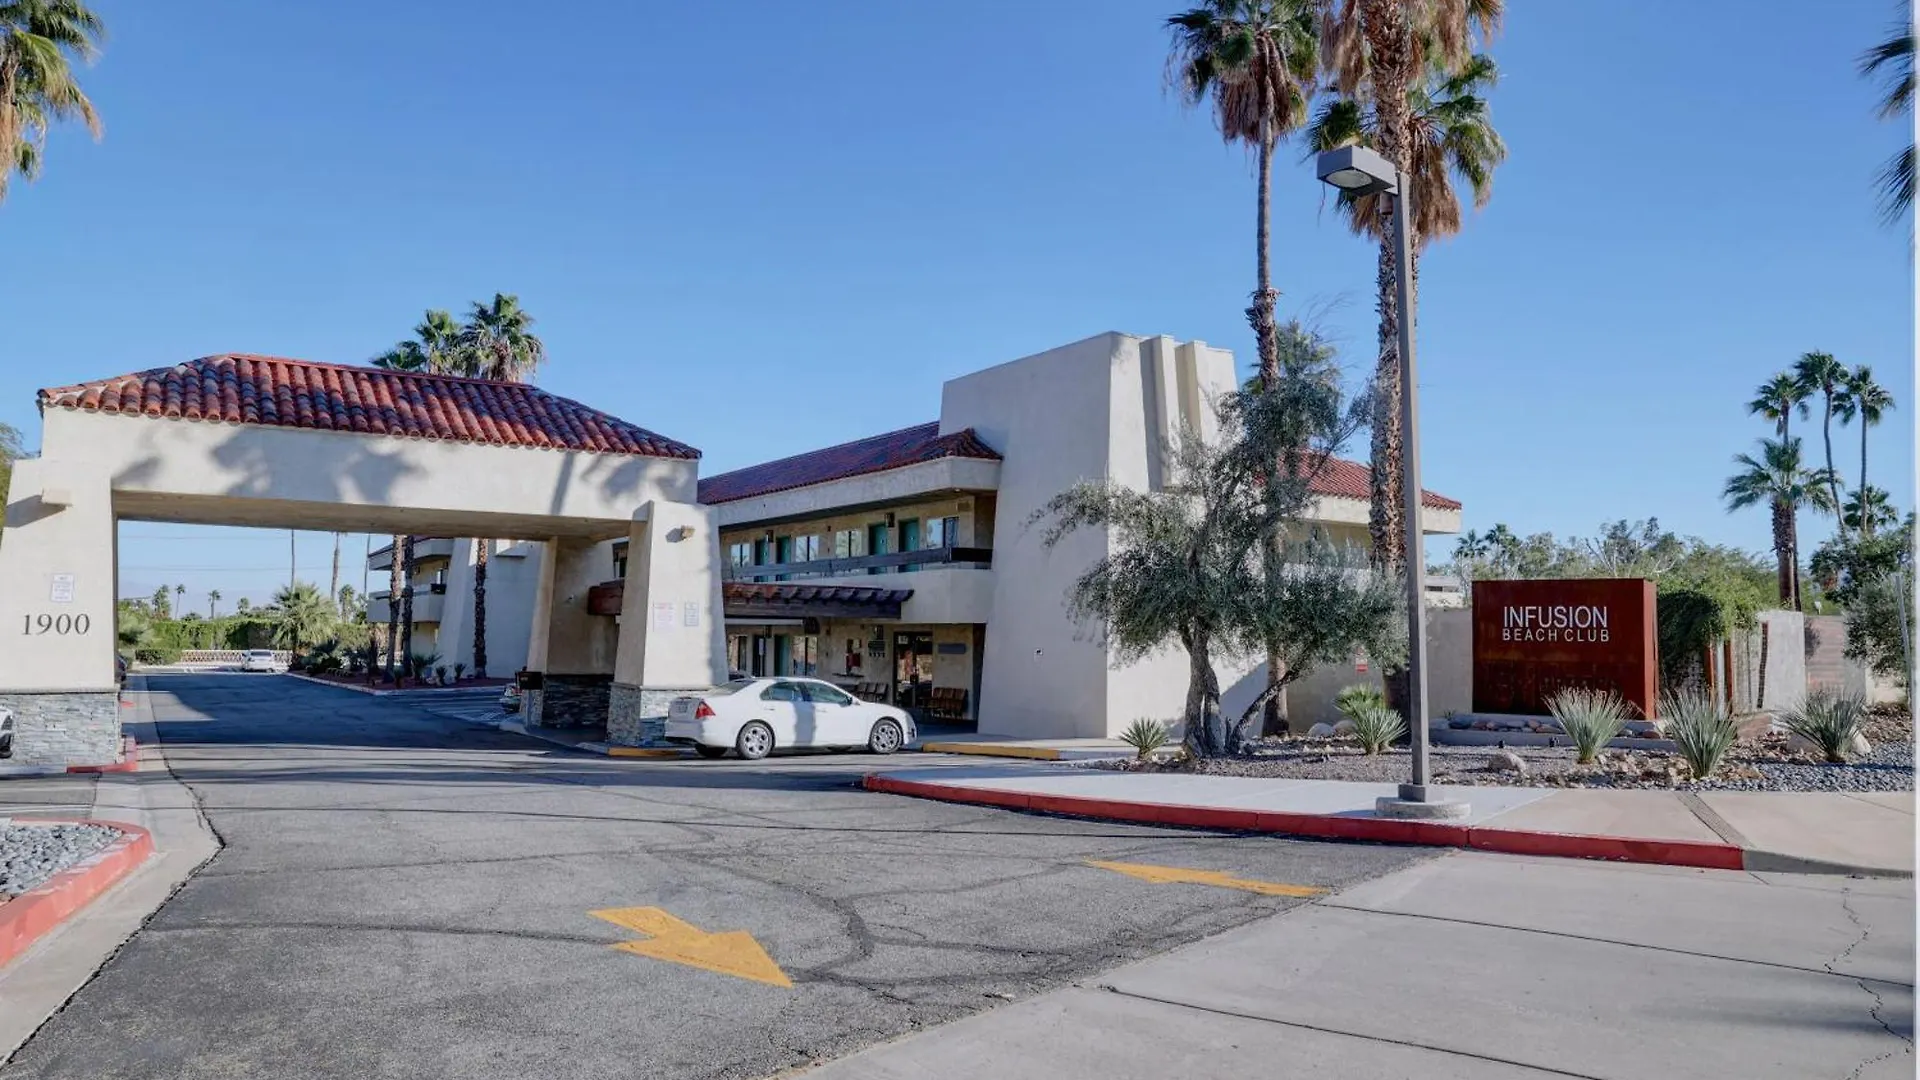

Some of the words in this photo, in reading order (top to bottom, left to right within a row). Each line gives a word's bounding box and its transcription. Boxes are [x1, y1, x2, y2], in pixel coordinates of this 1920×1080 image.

[22, 613, 90, 636] 1900
[1504, 606, 1607, 628] INFUSION
[1502, 628, 1557, 641] BEACH
[1564, 629, 1609, 642] CLUB
